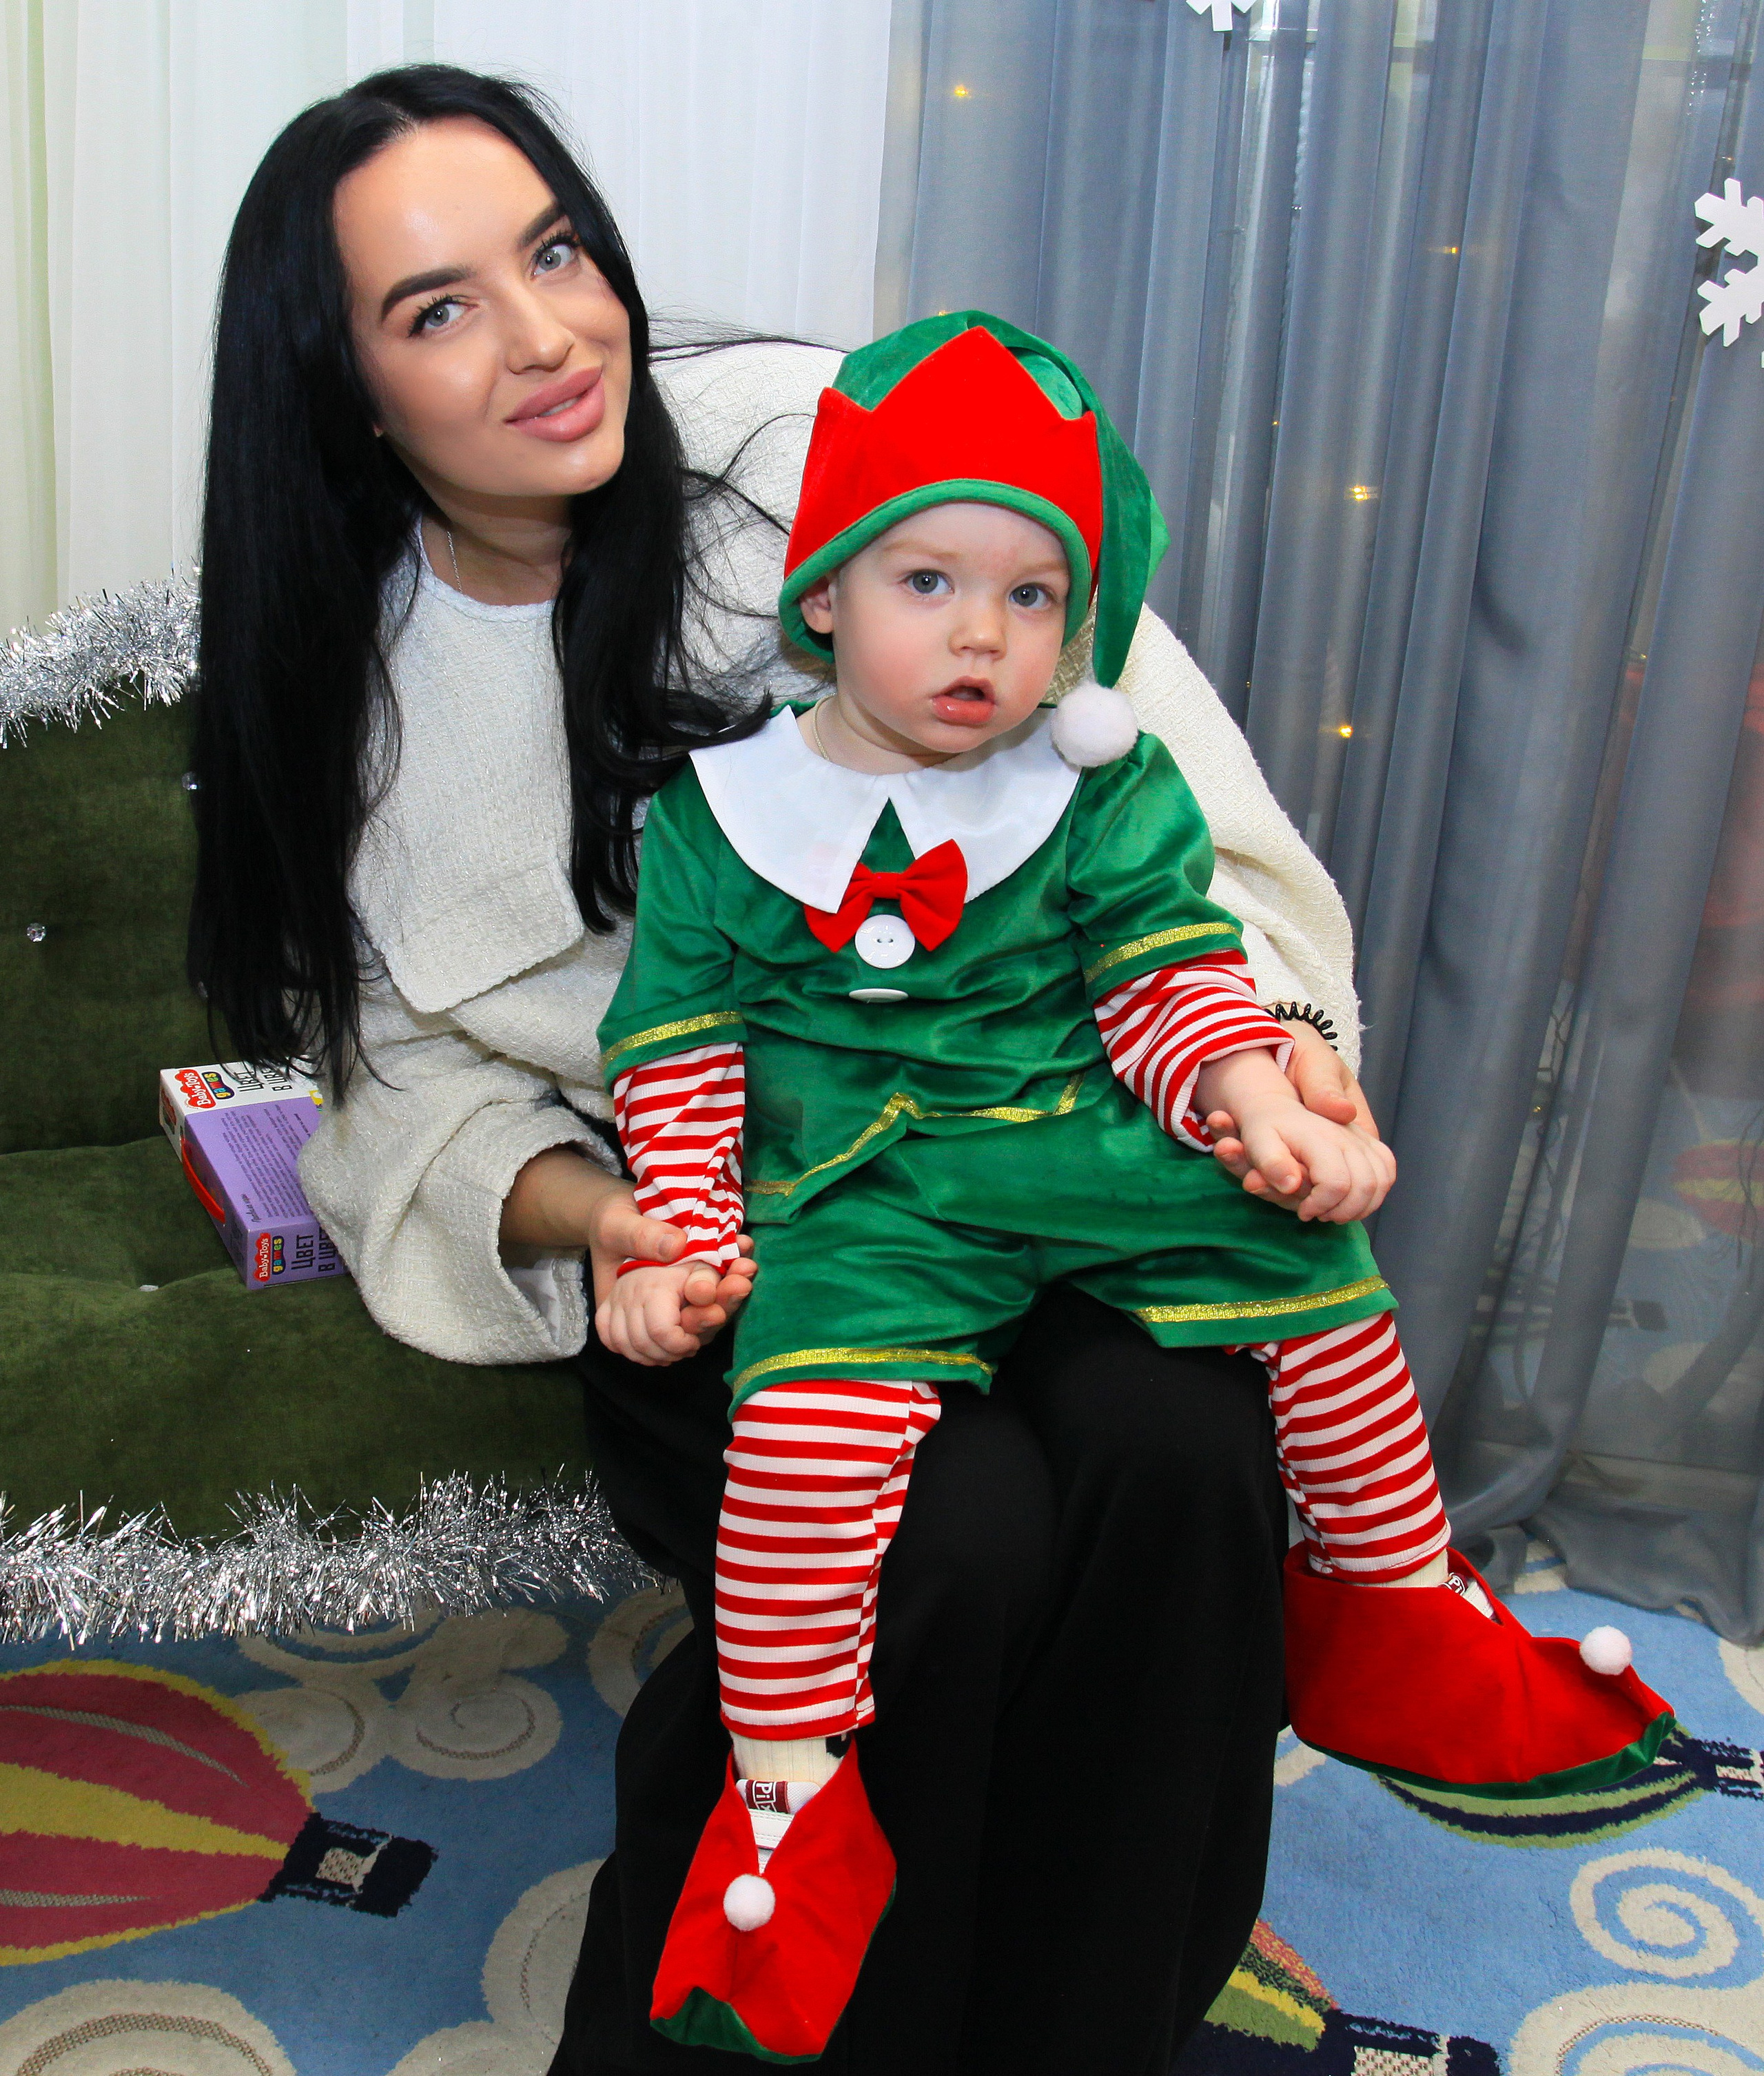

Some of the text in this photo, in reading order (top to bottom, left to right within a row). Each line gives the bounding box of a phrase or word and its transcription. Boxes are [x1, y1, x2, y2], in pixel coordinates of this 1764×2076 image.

[183, 1072, 200, 1087] Toys
[204, 1073, 232, 1098] games
[192, 1088, 212, 1106] Baby
[258, 1238, 270, 1278] Baby Toys
[273, 1238, 283, 1273] games
[291, 1235, 316, 1270] ЦВЕТ
